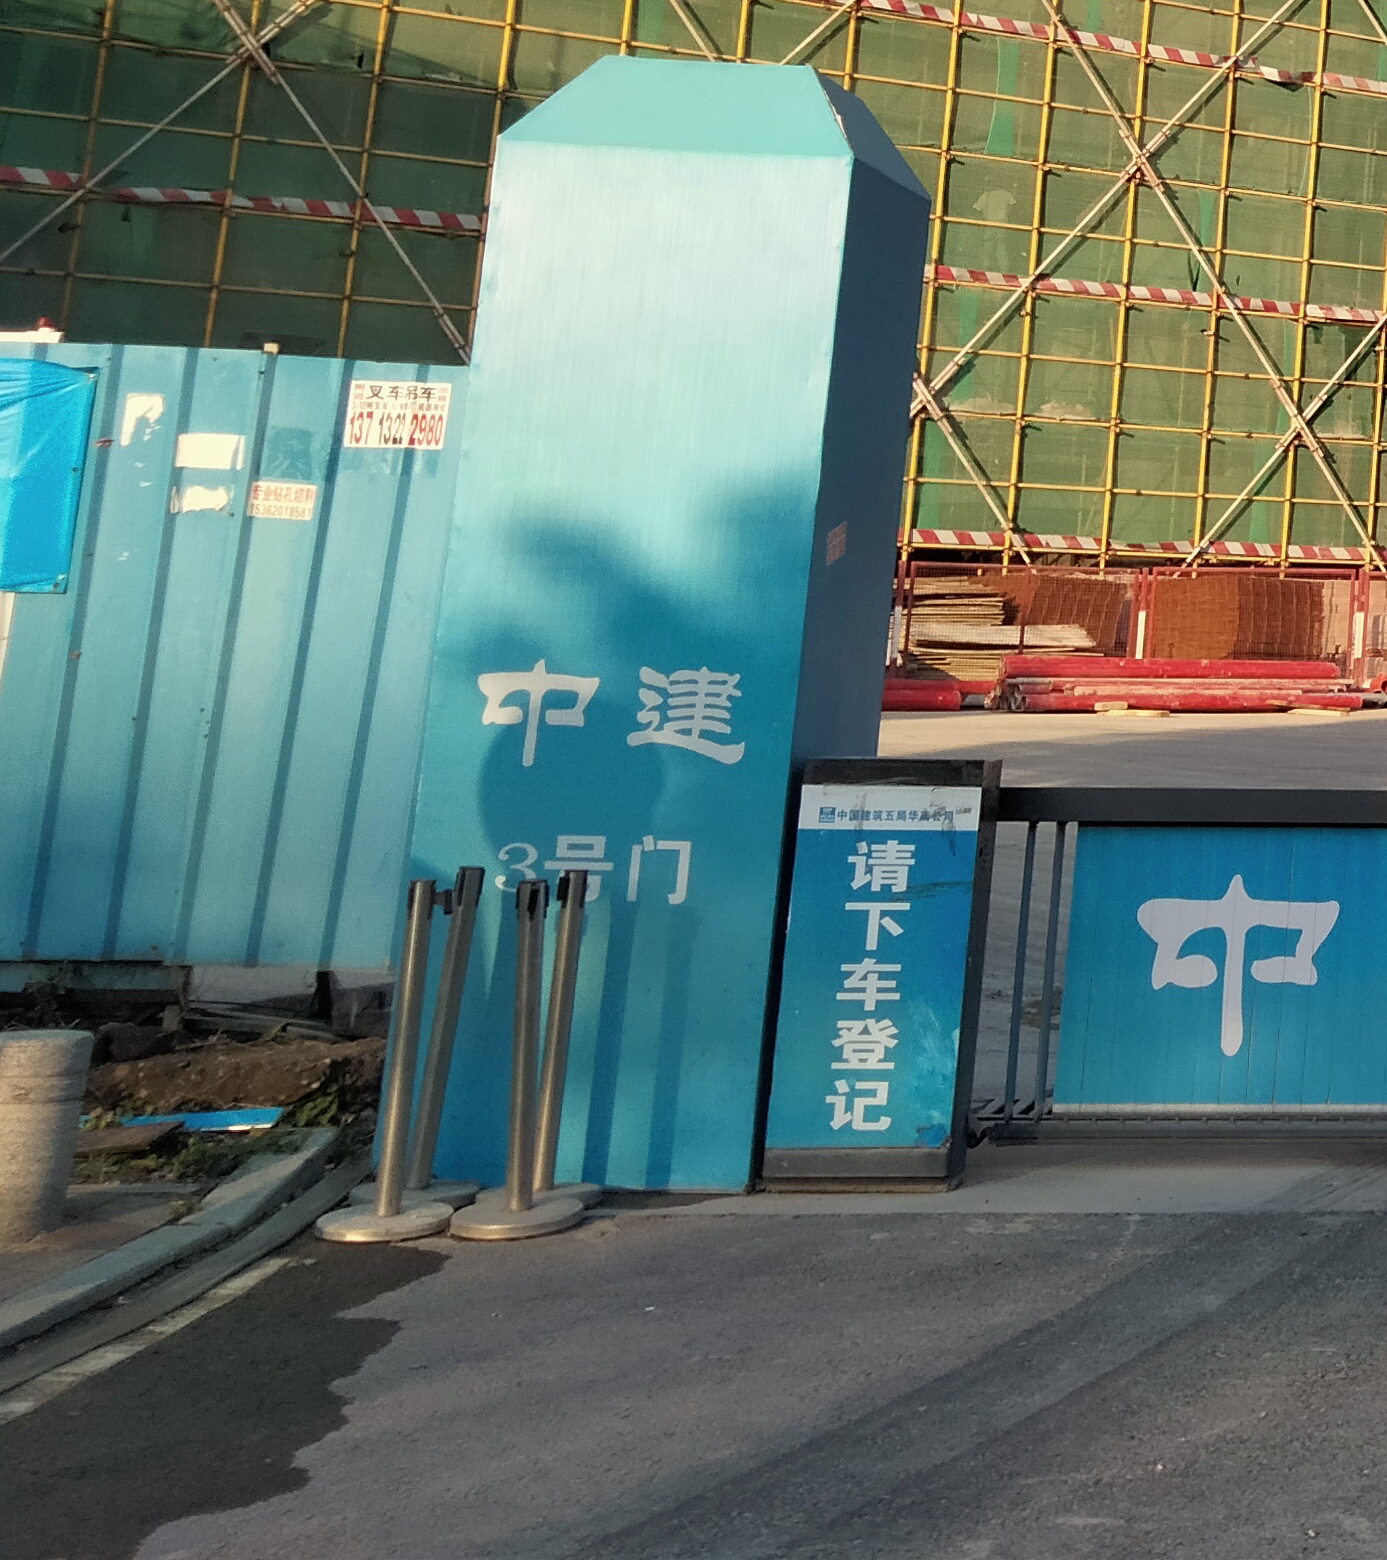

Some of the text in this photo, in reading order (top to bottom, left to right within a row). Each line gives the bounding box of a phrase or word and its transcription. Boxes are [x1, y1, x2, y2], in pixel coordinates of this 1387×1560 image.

[349, 410, 374, 446] 137
[408, 413, 444, 447] 2980
[476, 658, 746, 767] 中建
[825, 840, 916, 1132] 请下车登记
